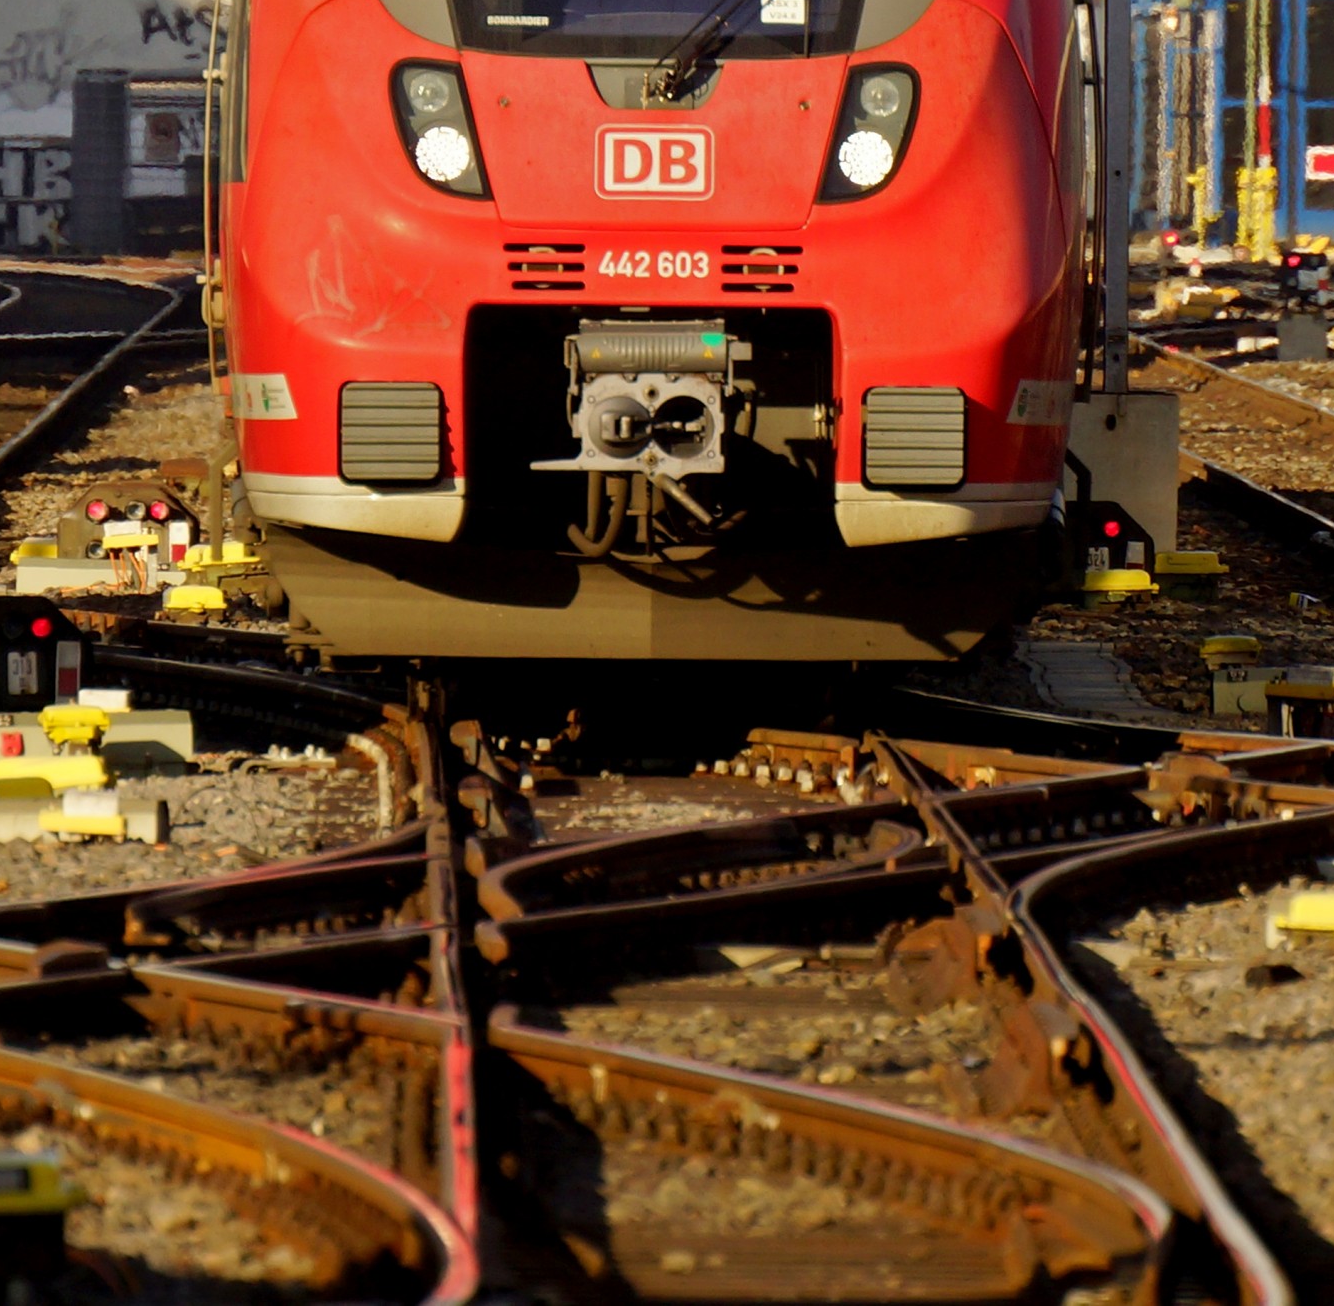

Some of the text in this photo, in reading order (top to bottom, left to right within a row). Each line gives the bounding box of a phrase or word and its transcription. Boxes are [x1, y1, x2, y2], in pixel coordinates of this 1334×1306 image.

[486, 14, 550, 27] BOMBARDIER
[612, 138, 698, 185] DB
[598, 250, 710, 279] 442 603
